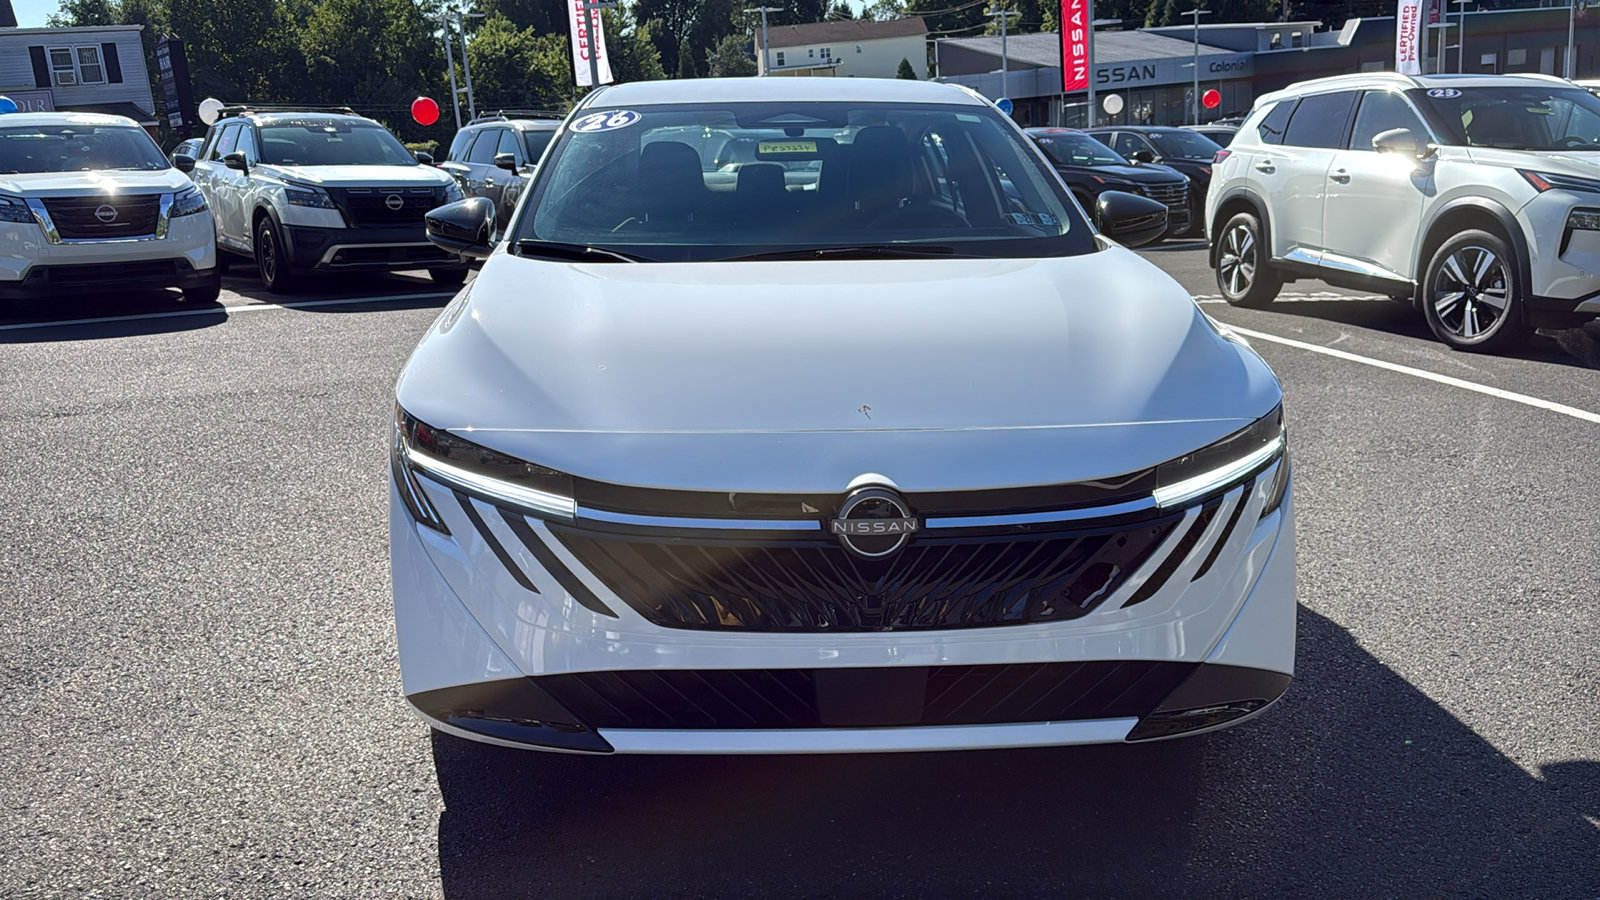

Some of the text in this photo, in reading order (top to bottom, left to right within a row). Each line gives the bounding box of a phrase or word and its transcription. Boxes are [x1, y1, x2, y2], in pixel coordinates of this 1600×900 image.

[1071, 0, 1085, 80] NISSAN
[1400, 6, 1410, 62] CERTIFIED
[1408, 6, 1417, 62] Pre-Owned
[1096, 65, 1156, 84] SSAN
[1209, 60, 1249, 73] Colonial
[580, 111, 630, 131] 26
[833, 521, 916, 532] NISSAN
